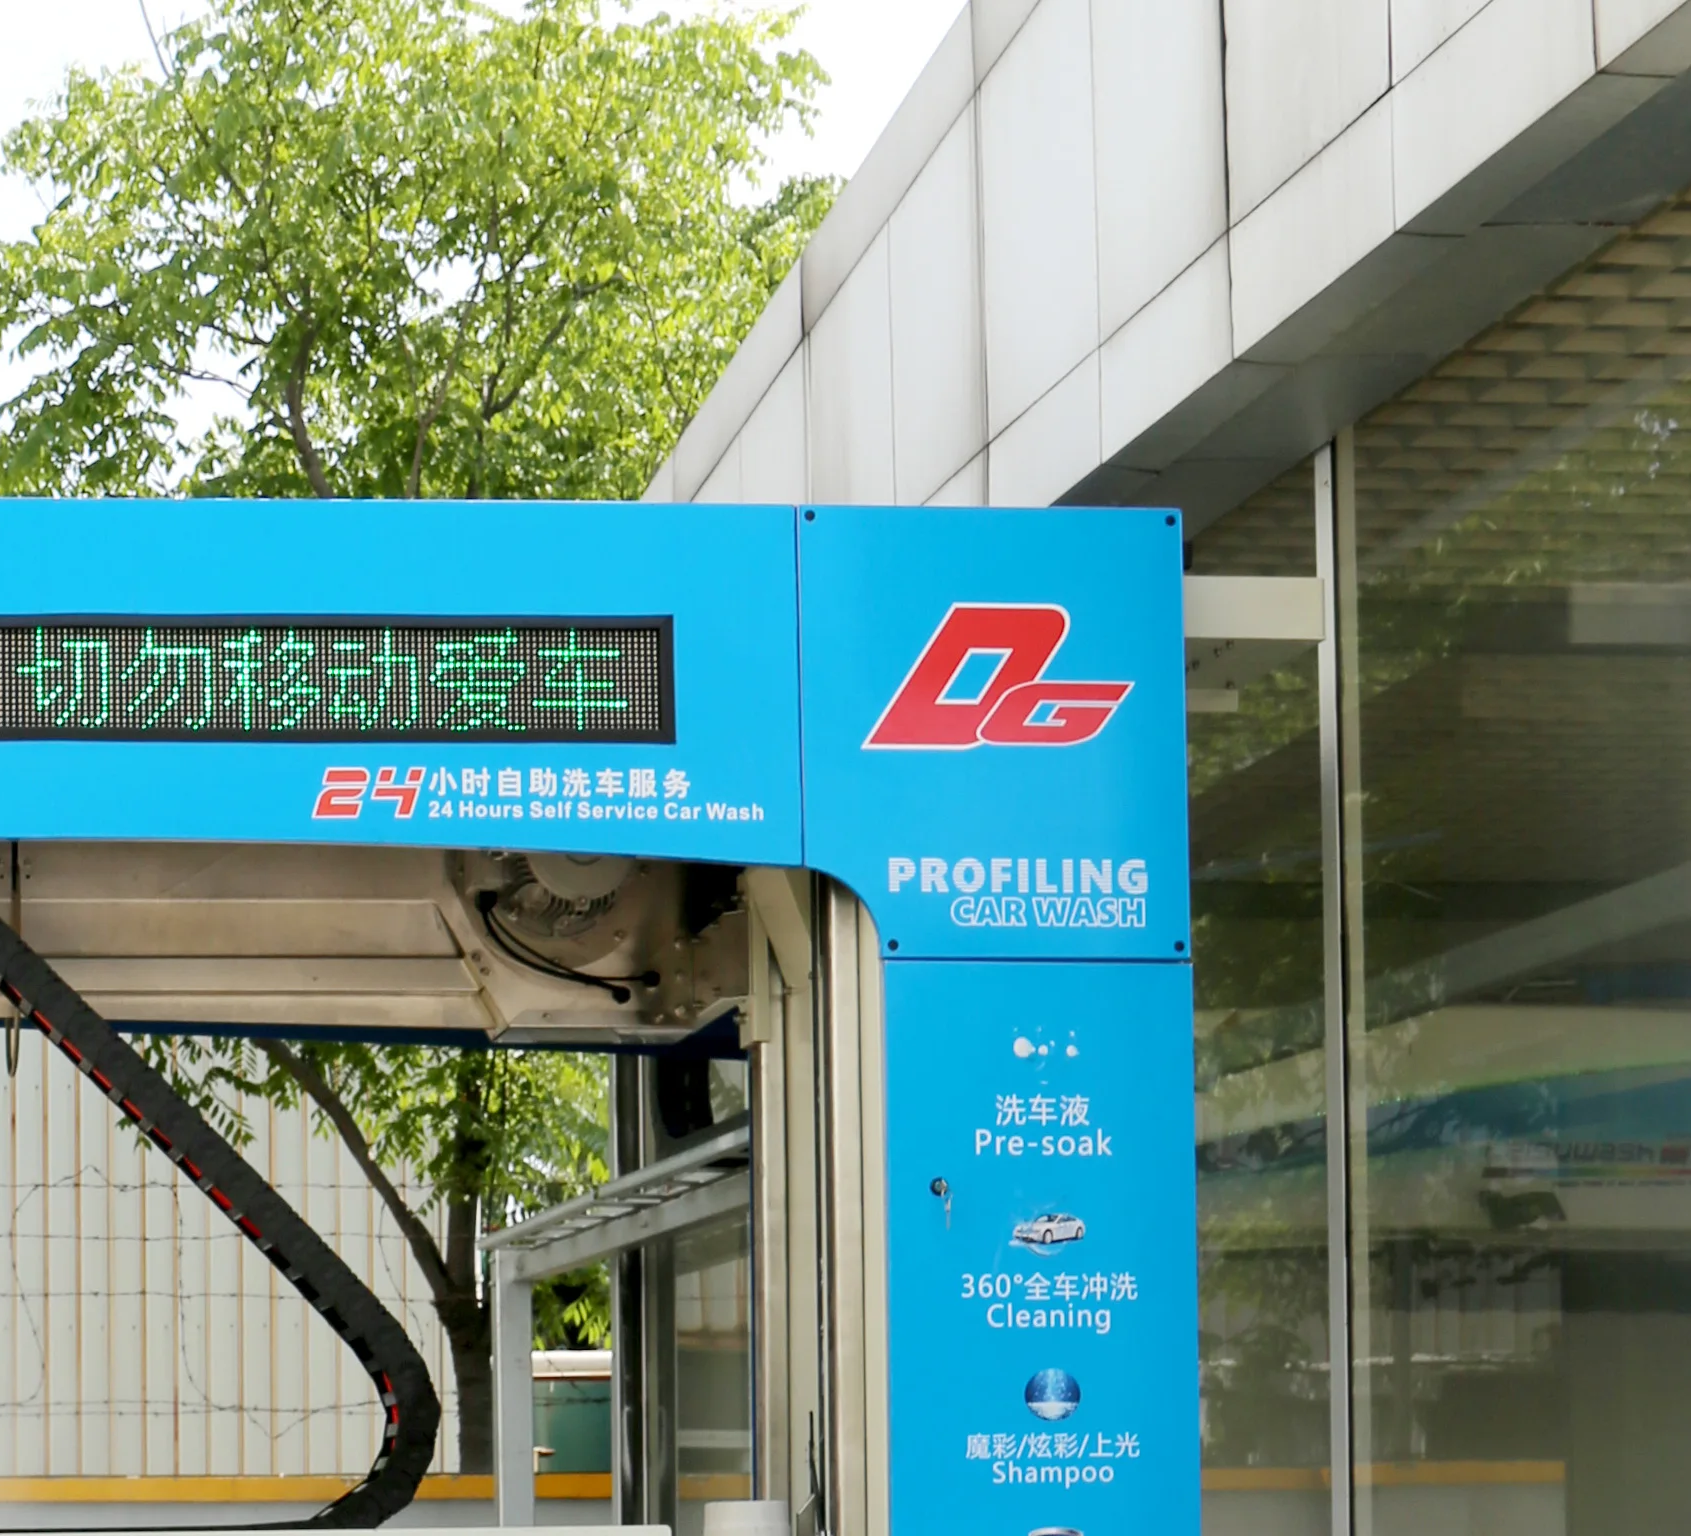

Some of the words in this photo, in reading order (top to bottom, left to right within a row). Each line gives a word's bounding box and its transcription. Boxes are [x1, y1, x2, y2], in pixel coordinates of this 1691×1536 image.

[16, 625, 629, 731] 切勿移动爱车
[428, 767, 692, 799] 小时自助洗车服务
[428, 802, 454, 819] 24
[459, 802, 524, 820] Hours
[529, 802, 572, 820] Self
[576, 802, 659, 821] Service
[663, 803, 702, 821] Car
[706, 804, 766, 822] Wash
[887, 857, 1149, 894] PROFILING
[950, 896, 1027, 927] CAR
[1031, 897, 1147, 928] WASH
[995, 1093, 1090, 1127] 洗车液
[974, 1128, 1113, 1157] Pre-soak
[961, 1271, 1139, 1301] 360°全车冲洗
[986, 1303, 1112, 1334] Cleaning
[965, 1431, 1141, 1460] 魔彩/炫彩/上光
[992, 1461, 1115, 1489] Shampoo
